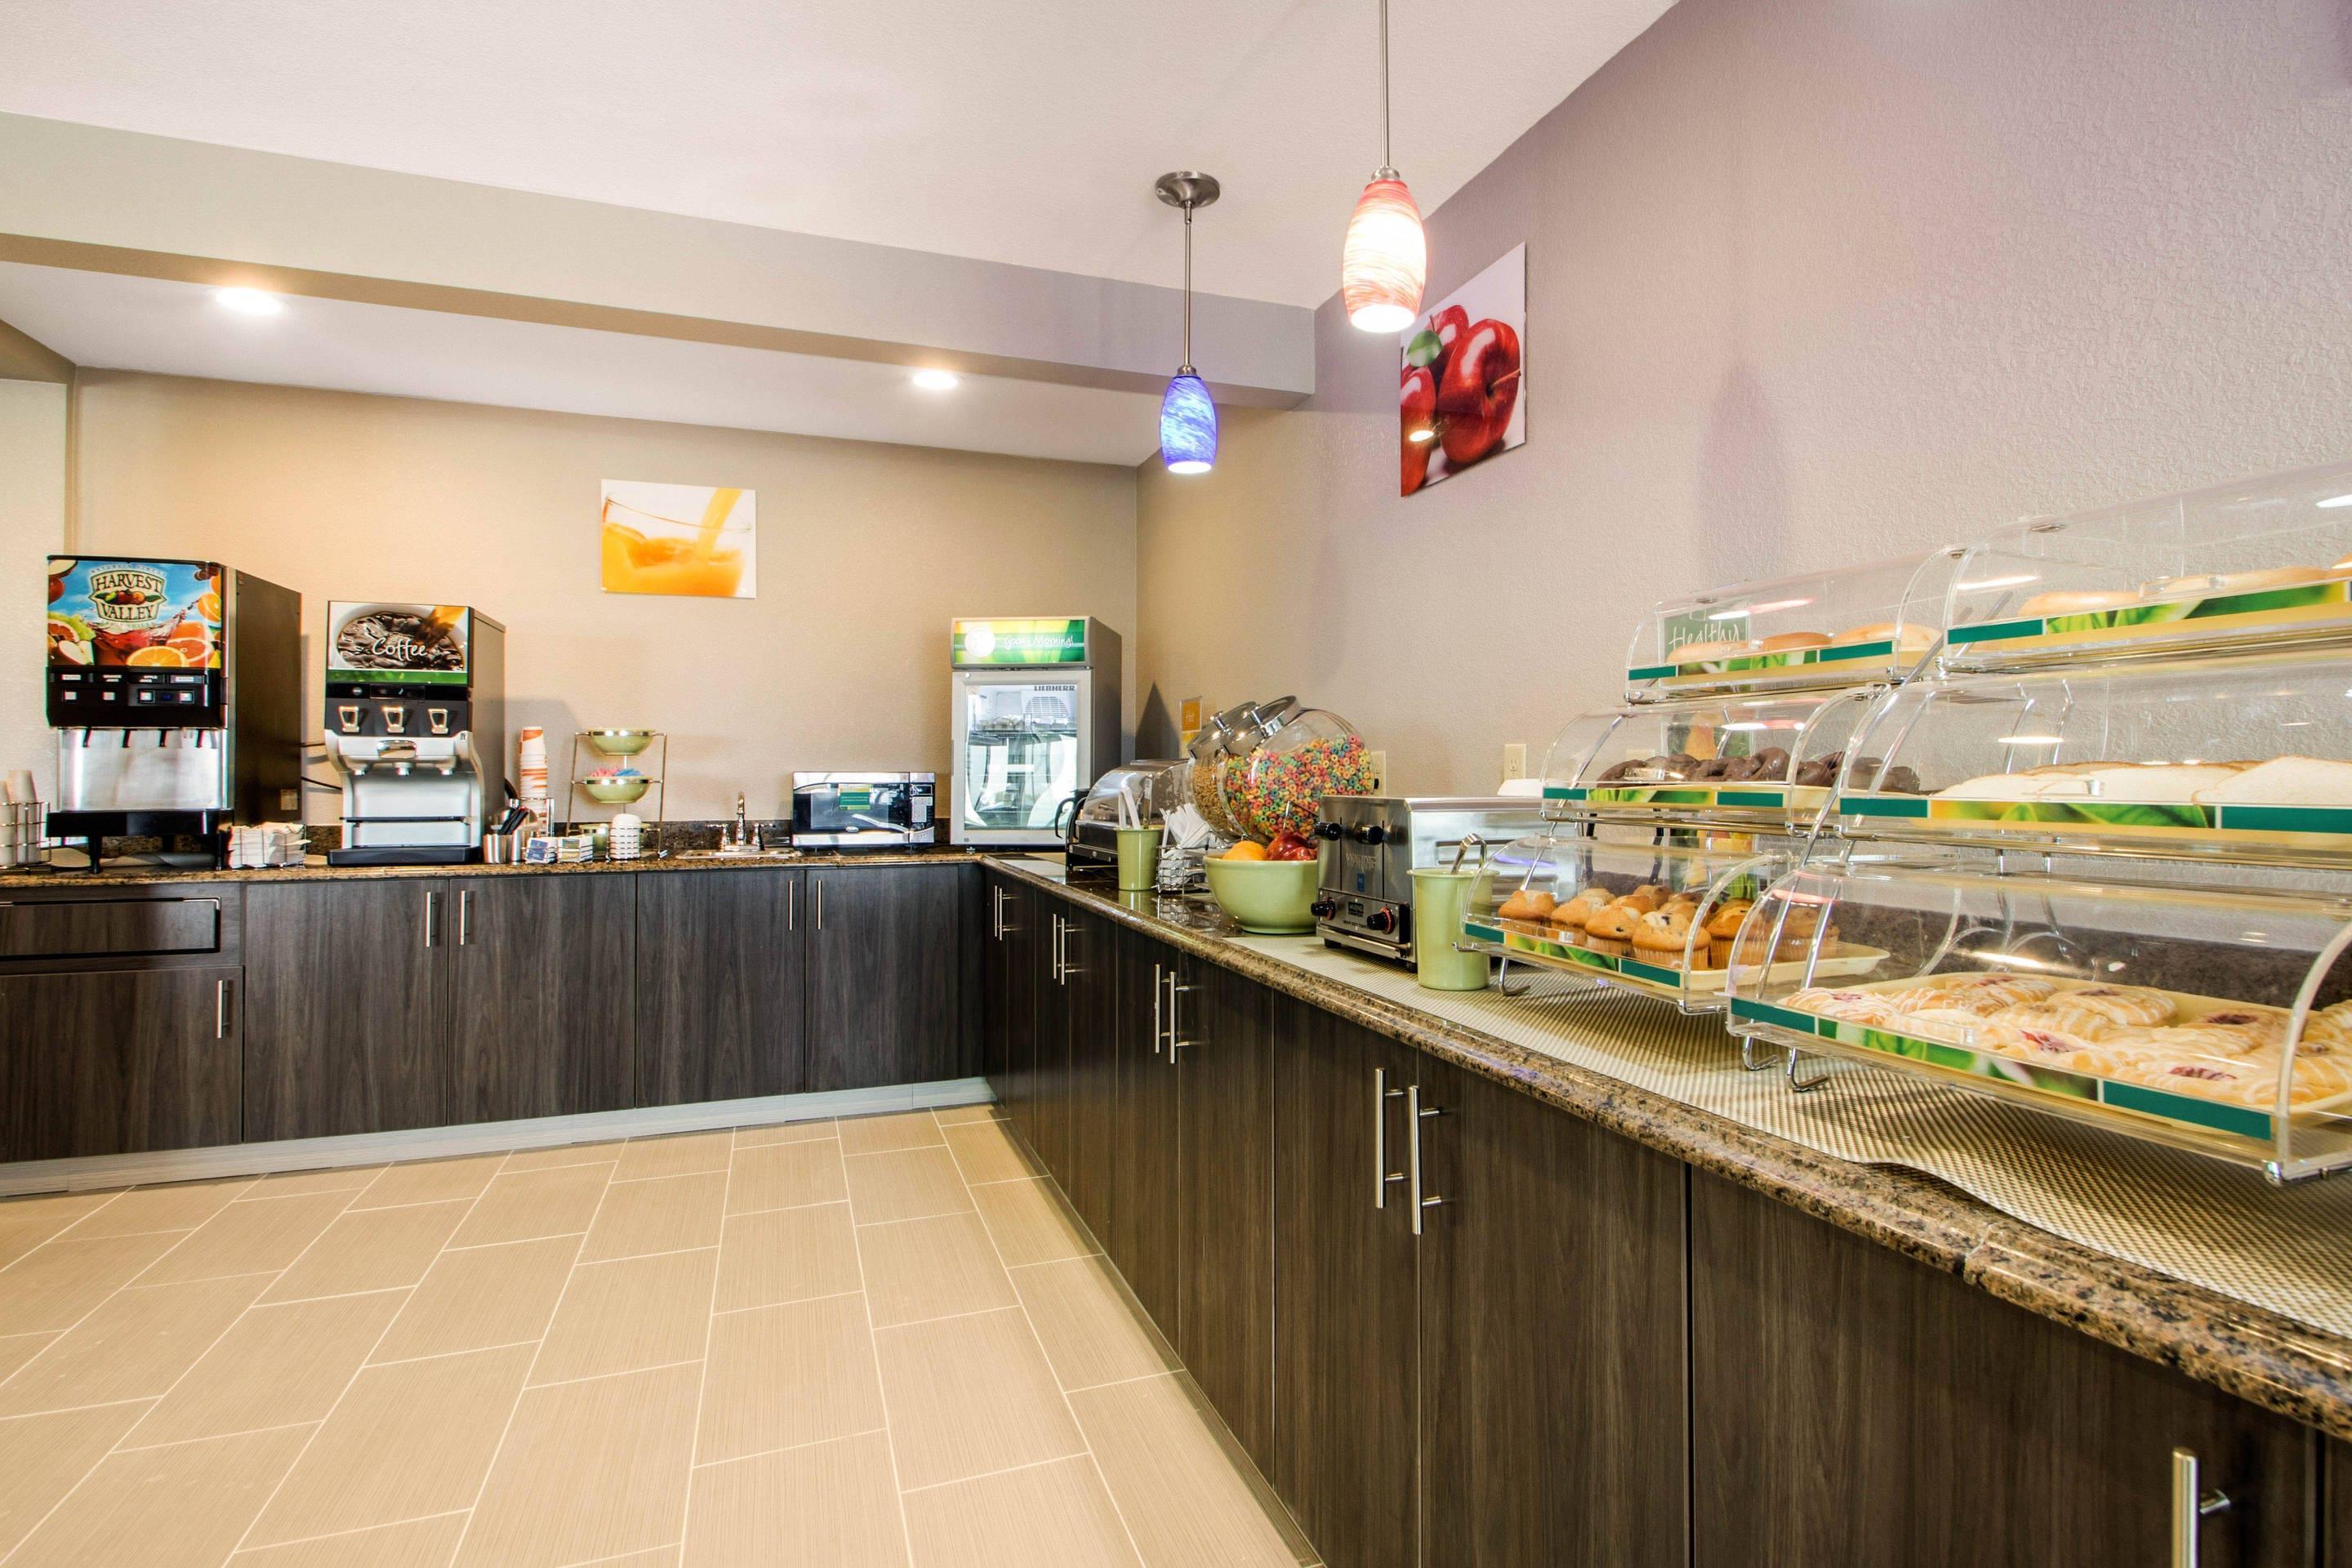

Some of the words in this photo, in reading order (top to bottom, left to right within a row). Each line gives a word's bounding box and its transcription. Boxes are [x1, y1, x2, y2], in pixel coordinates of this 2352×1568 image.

[96, 574, 163, 592] HARVEST
[100, 603, 154, 620] VALLEY
[1668, 620, 1740, 651] Healthy
[372, 636, 427, 662] Coffee
